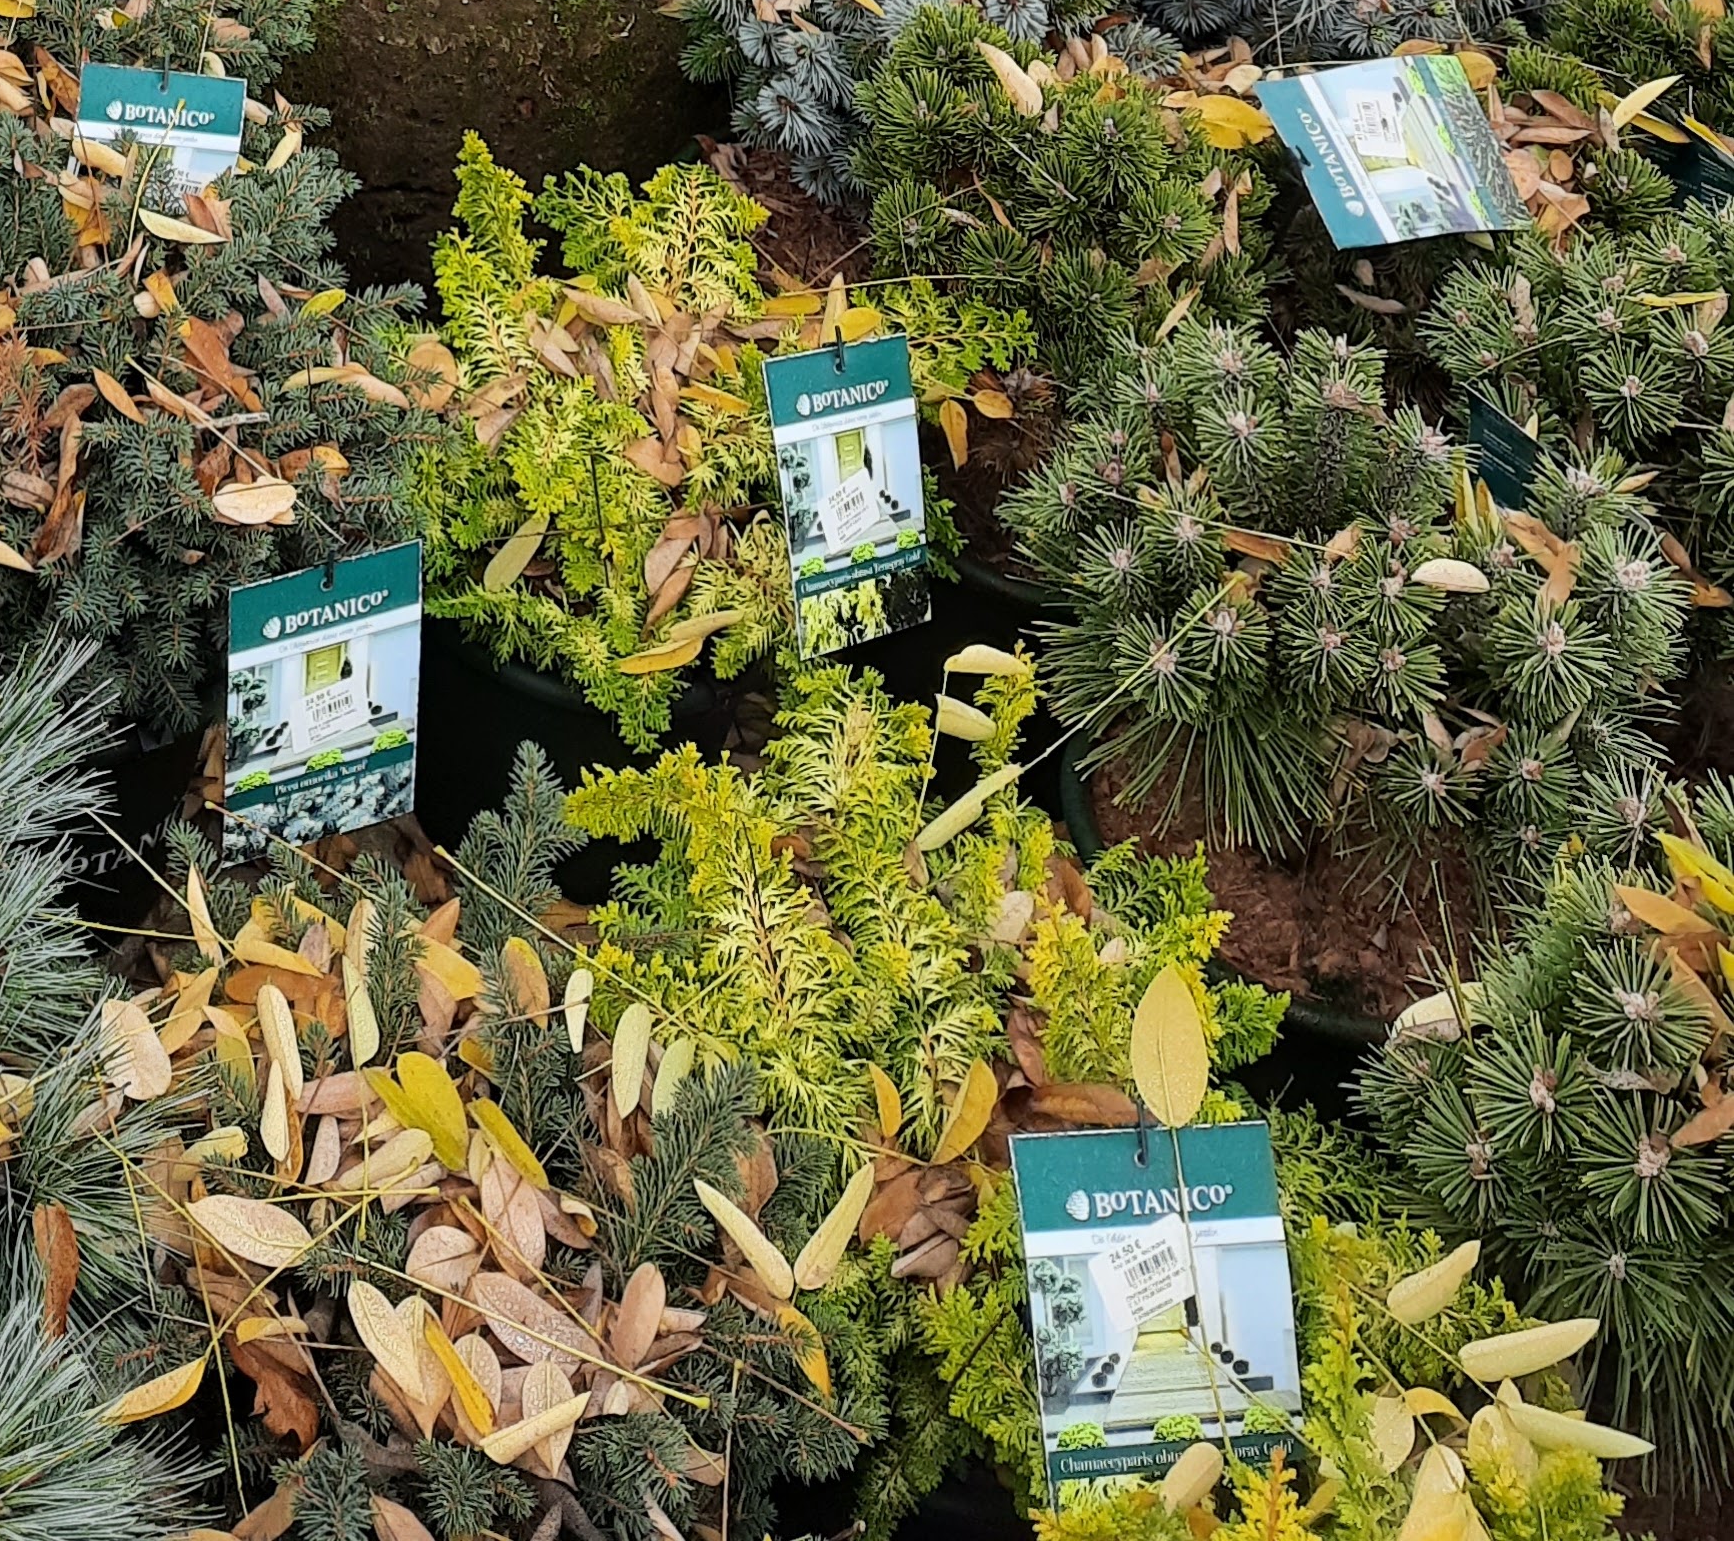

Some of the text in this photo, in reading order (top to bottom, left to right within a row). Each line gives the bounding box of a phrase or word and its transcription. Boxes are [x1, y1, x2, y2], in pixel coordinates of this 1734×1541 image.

[124, 104, 210, 128] BOTANICO
[1300, 112, 1355, 198] BOTANICO
[812, 380, 886, 412] BOTANICO
[284, 590, 384, 634] BOTANICO
[1092, 1184, 1226, 1218] BOTANICO
[1155, 1444, 1183, 1464] obtu
